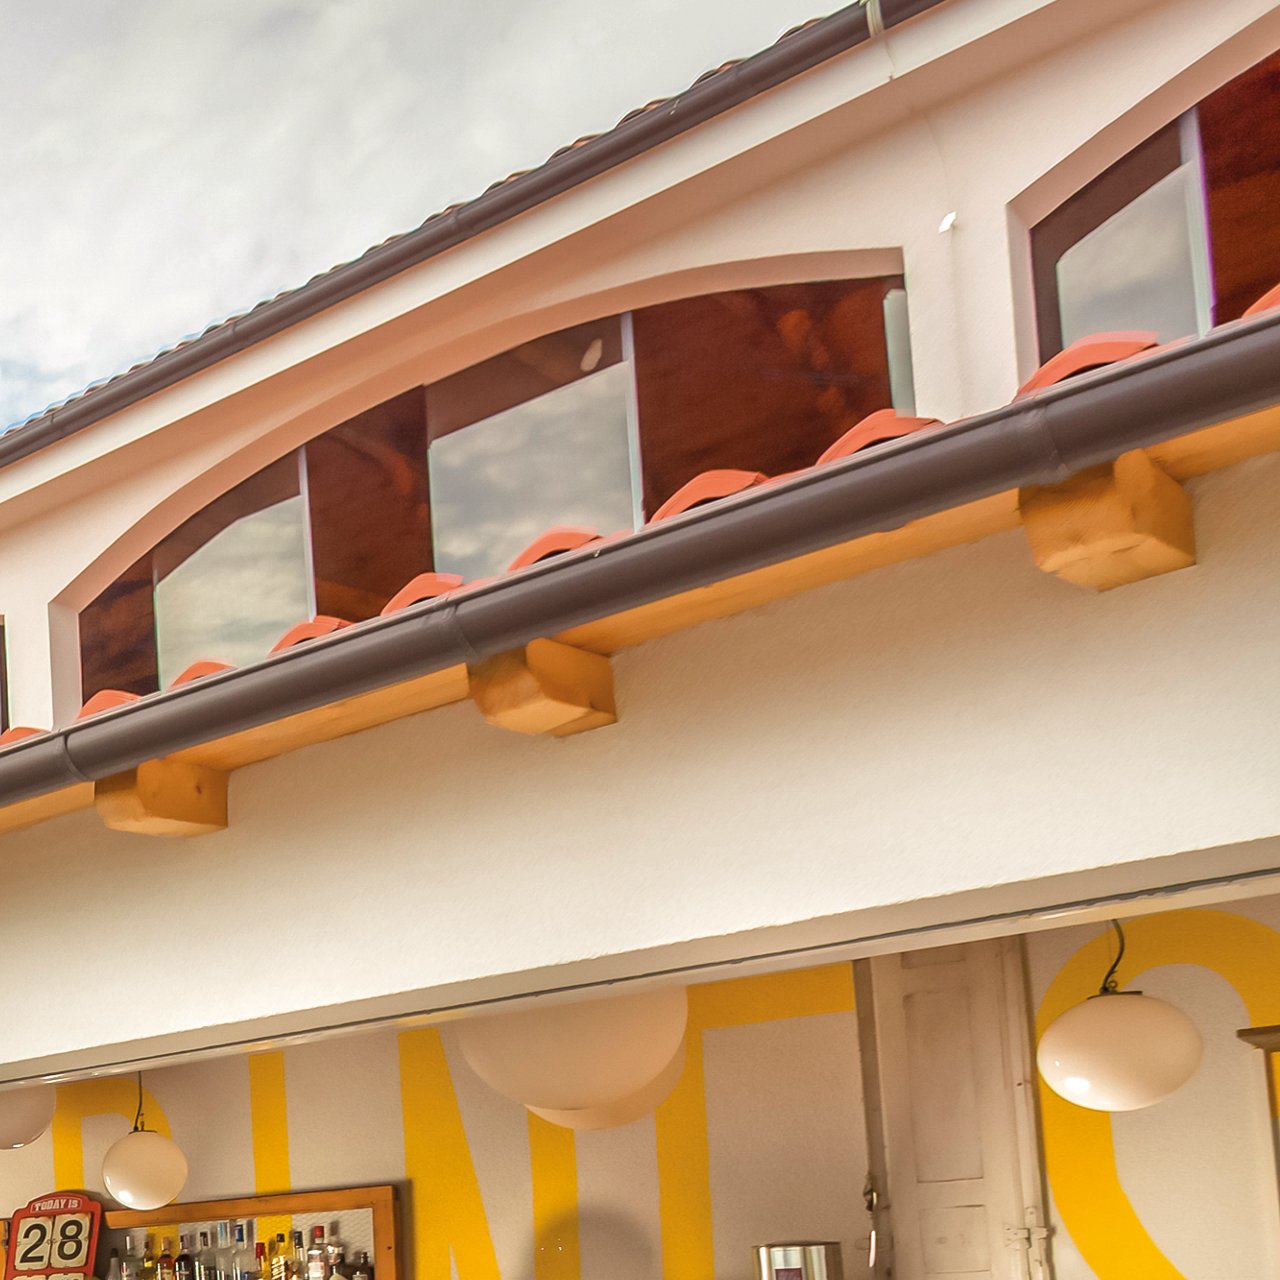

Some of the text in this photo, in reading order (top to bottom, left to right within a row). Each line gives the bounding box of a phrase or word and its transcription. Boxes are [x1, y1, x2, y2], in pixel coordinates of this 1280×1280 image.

[34, 1199, 79, 1212] TODAY IS
[19, 1219, 83, 1264] 28
